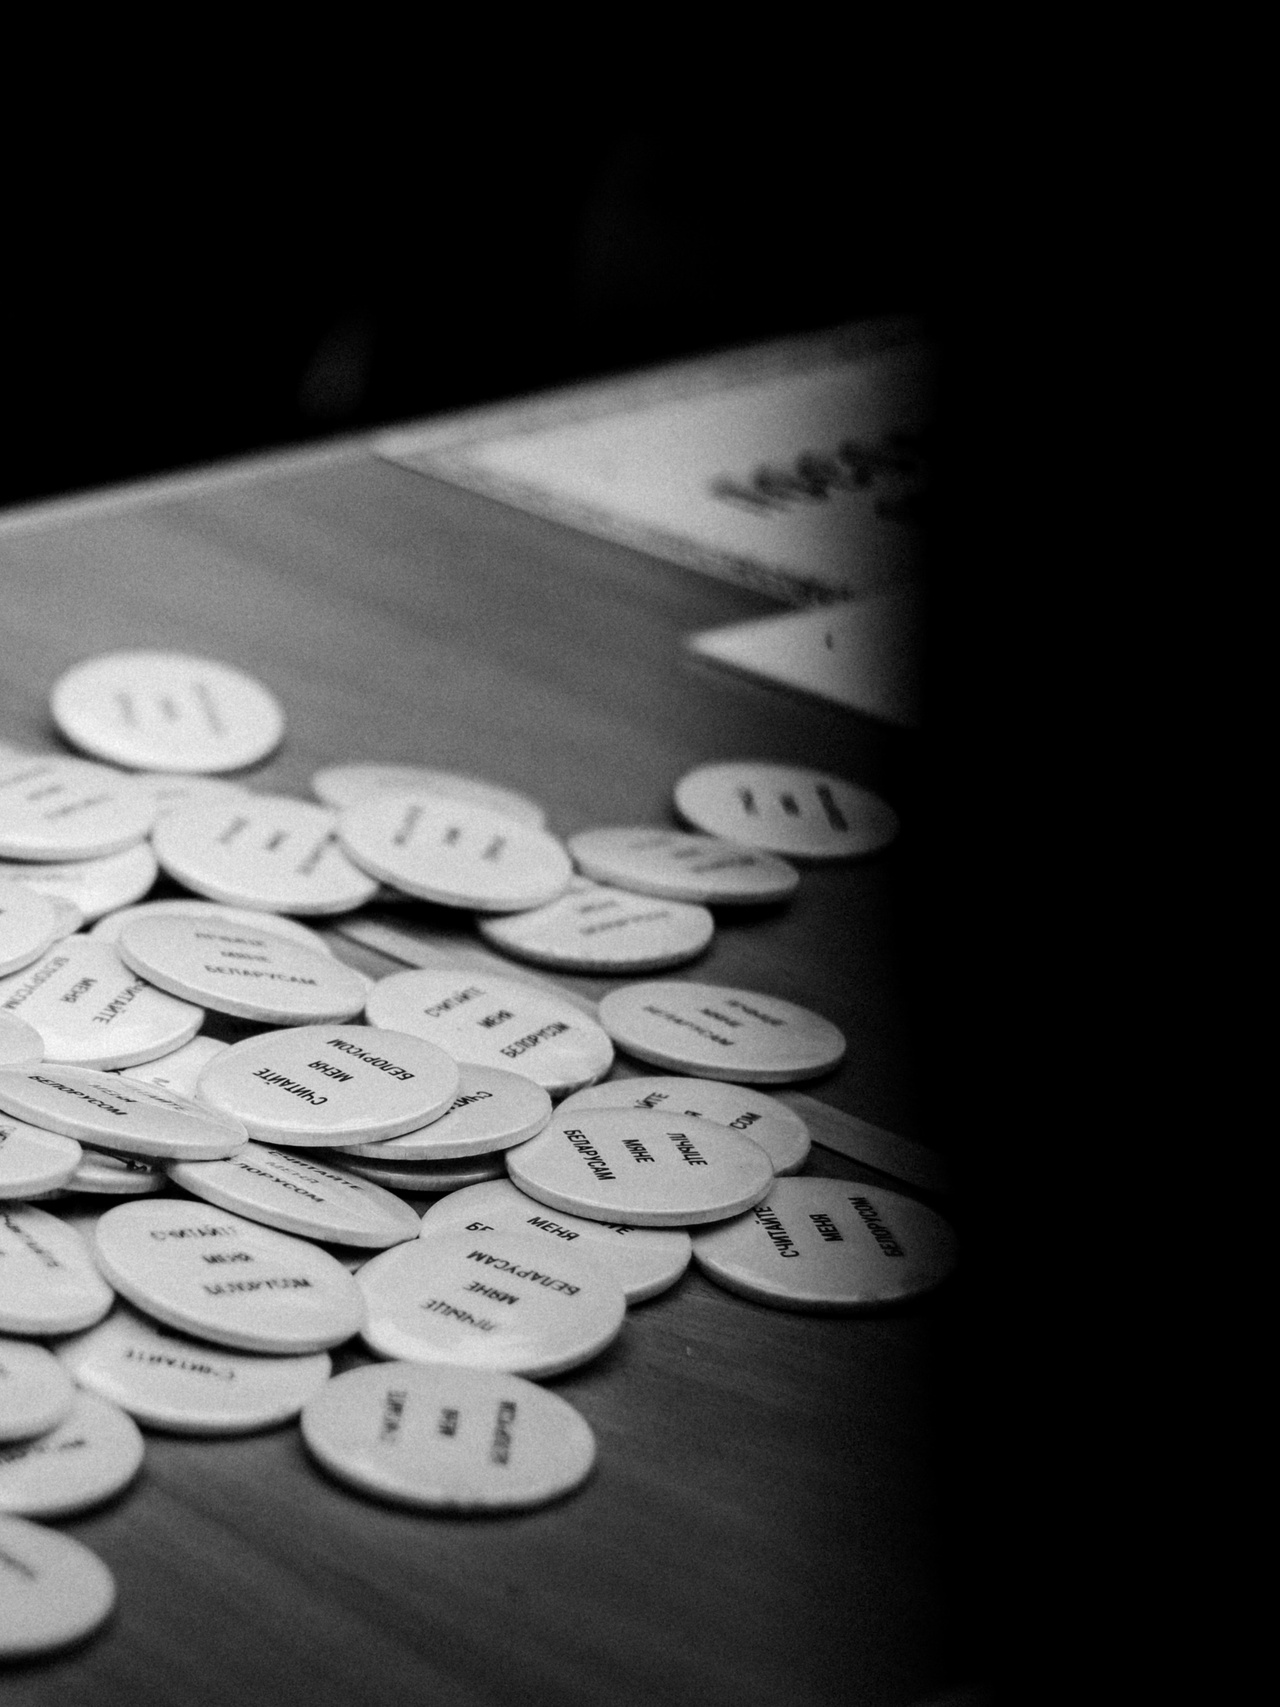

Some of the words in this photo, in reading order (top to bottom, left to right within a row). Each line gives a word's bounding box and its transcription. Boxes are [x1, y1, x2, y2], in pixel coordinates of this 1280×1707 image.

[60, 977, 98, 1004] МЕНЯ
[204, 963, 318, 986] БЕЛАРУСАМ
[476, 1008, 516, 1030] МЕНЯ
[499, 1020, 571, 1059] БЕЛОРУСОМ
[307, 1060, 355, 1083] МЕНЯ
[325, 1038, 416, 1081] БЕЛОРУСОМ
[28, 1075, 128, 1116] БЕЛОРУСОМ
[252, 1067, 329, 1106] СЧИТАЙТЕ
[563, 1128, 616, 1181] БЕЛАРУСАМ
[621, 1138, 656, 1164] МЯНЕ
[666, 1132, 708, 1166] ЛІЧЫЦЕ
[232, 1160, 325, 1203] ЛОРУСОМ
[265, 1161, 320, 1184] МЕНЯ
[268, 1150, 365, 1191] СЧИТАЙТЕ
[527, 1215, 581, 1242] МЕНЯ
[753, 1204, 800, 1259] СЧИТАЙТЕ
[809, 1213, 844, 1243] МЕНЯ
[848, 1196, 905, 1258] БЕЛОРУСОМ
[467, 1250, 582, 1297] БЕЛАРУСАМ
[462, 1280, 520, 1306] МЯНЕ
